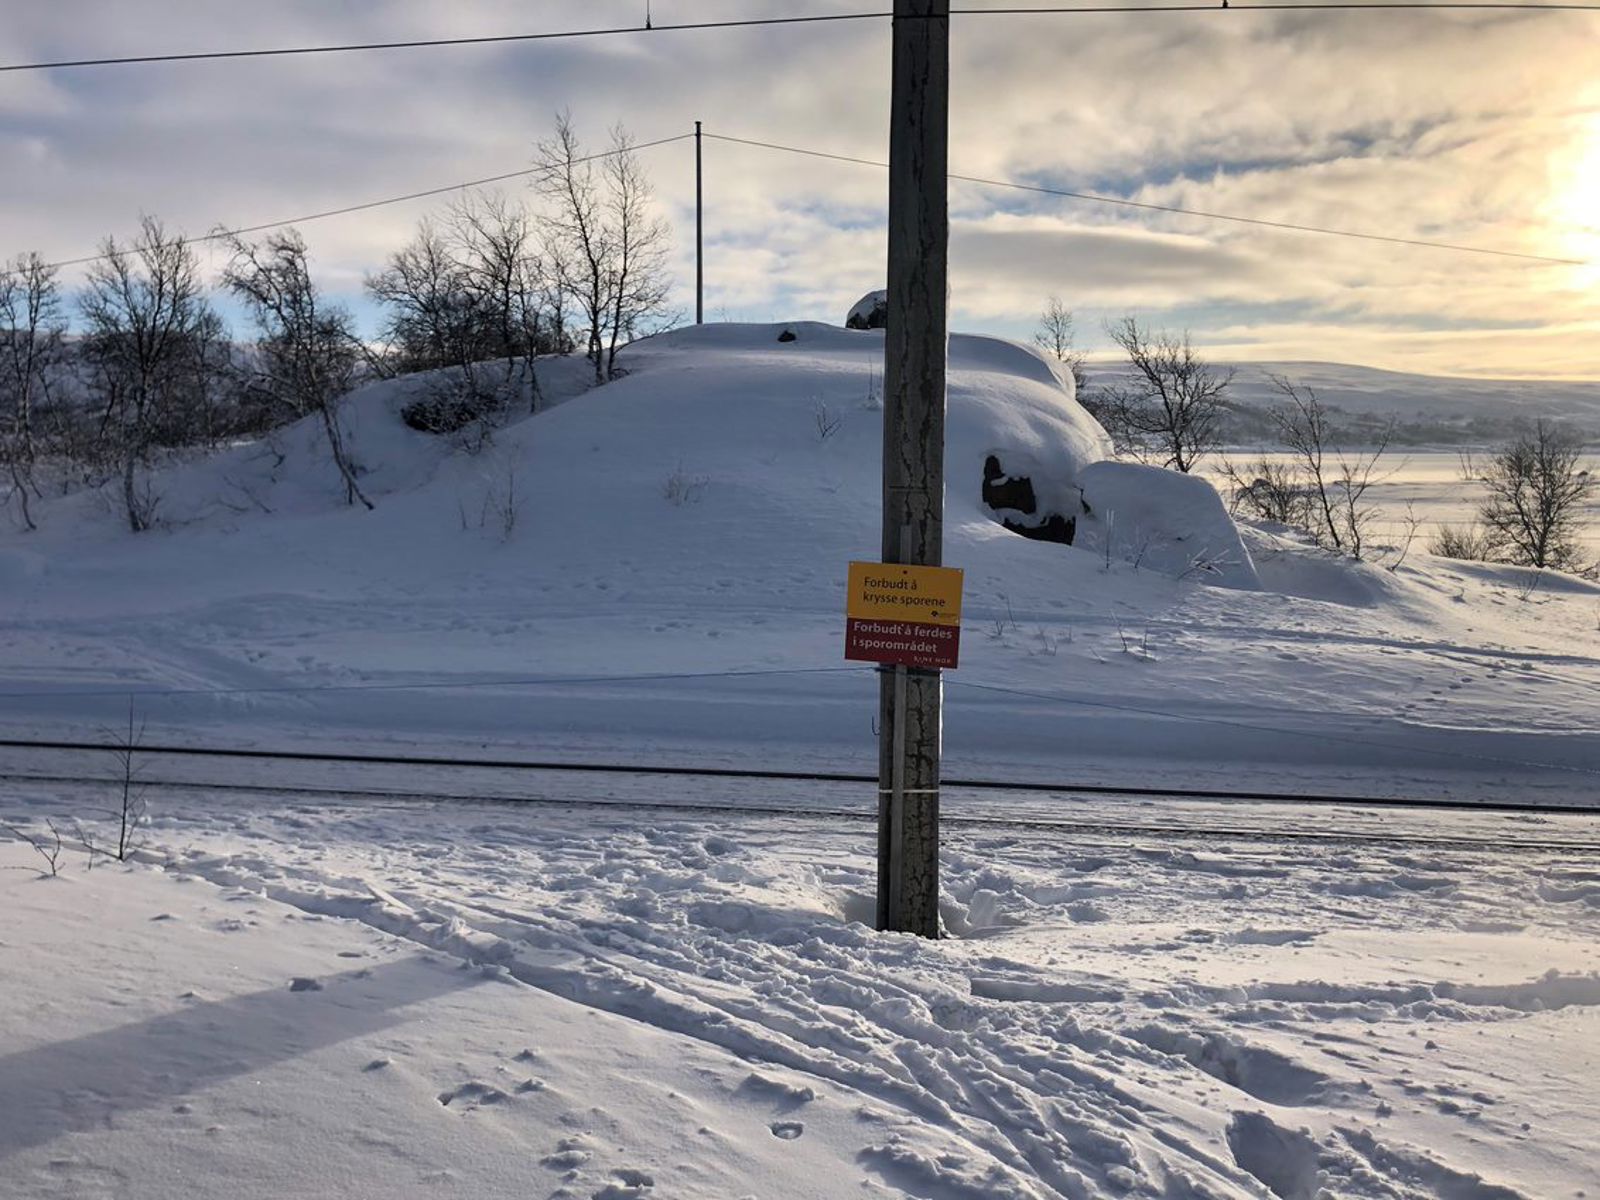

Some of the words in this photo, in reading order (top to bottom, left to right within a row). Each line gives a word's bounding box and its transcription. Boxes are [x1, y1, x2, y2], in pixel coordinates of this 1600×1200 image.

[864, 576, 908, 590] Forbudt
[910, 581, 917, 590] å
[863, 592, 898, 604] krysse
[900, 595, 946, 607] sporene
[854, 622, 902, 635] Forbudt
[904, 625, 912, 635] å
[914, 626, 953, 640] ferdes
[859, 639, 937, 653] sporområdet
